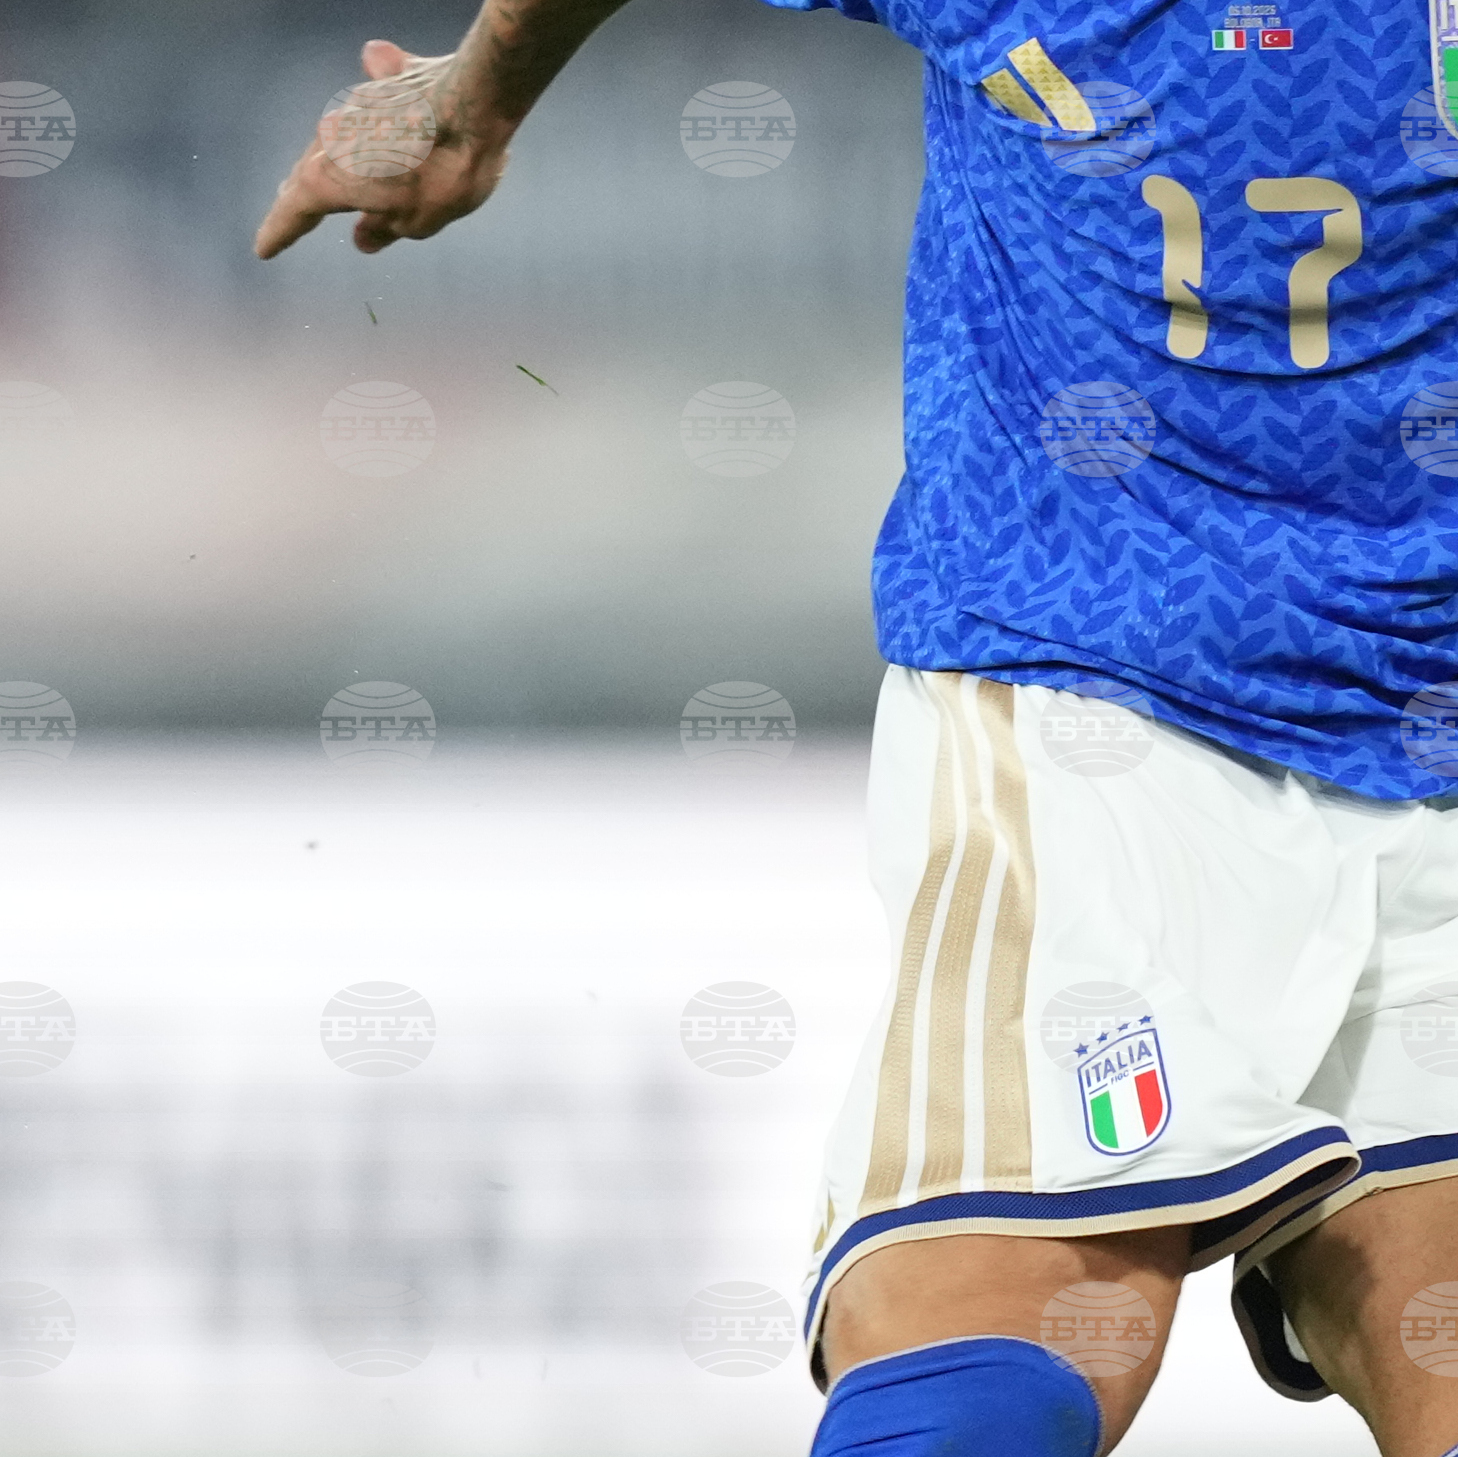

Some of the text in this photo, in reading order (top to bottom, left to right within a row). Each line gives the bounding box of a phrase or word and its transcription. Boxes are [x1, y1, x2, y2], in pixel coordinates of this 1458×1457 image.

[1141, 174, 1362, 369] 17
[1084, 1039, 1153, 1088] ITALIA
[1111, 1070, 1130, 1085] FIGC
